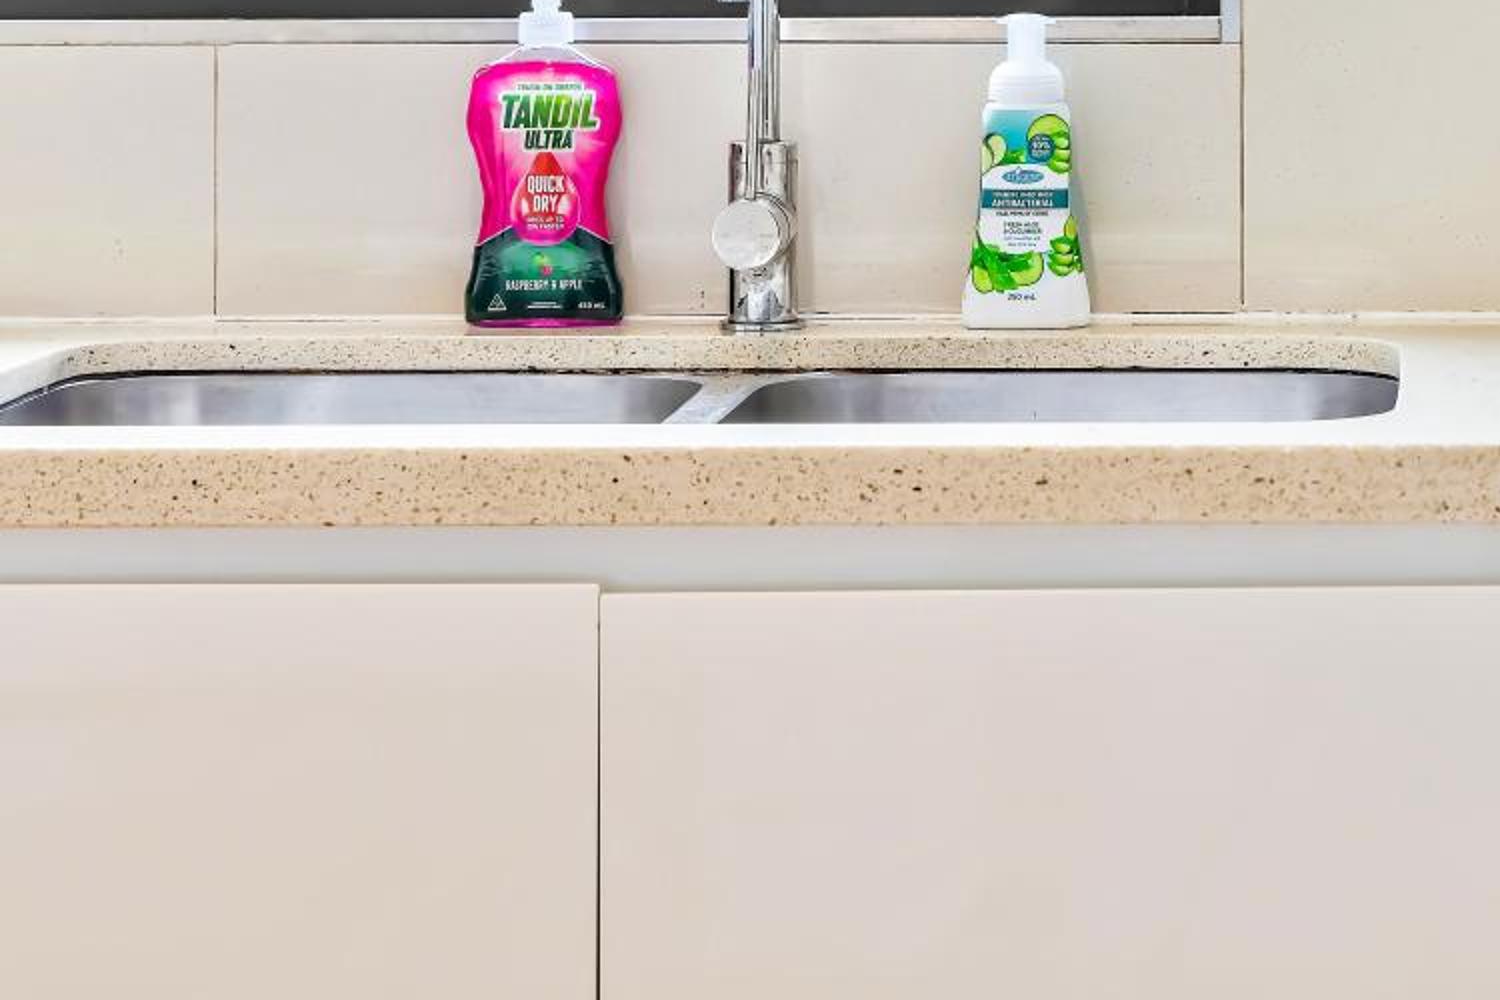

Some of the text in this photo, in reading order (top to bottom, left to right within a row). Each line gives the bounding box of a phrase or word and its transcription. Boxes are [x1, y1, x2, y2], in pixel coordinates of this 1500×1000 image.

[502, 93, 598, 129] TANDIL
[525, 129, 574, 150] ULTRA
[527, 174, 566, 194] QUICK
[533, 194, 560, 214] DRY
[991, 198, 1053, 208] ANTIBACTERIAL
[505, 279, 549, 291] RASPBERRY
[559, 279, 583, 291] APPLE
